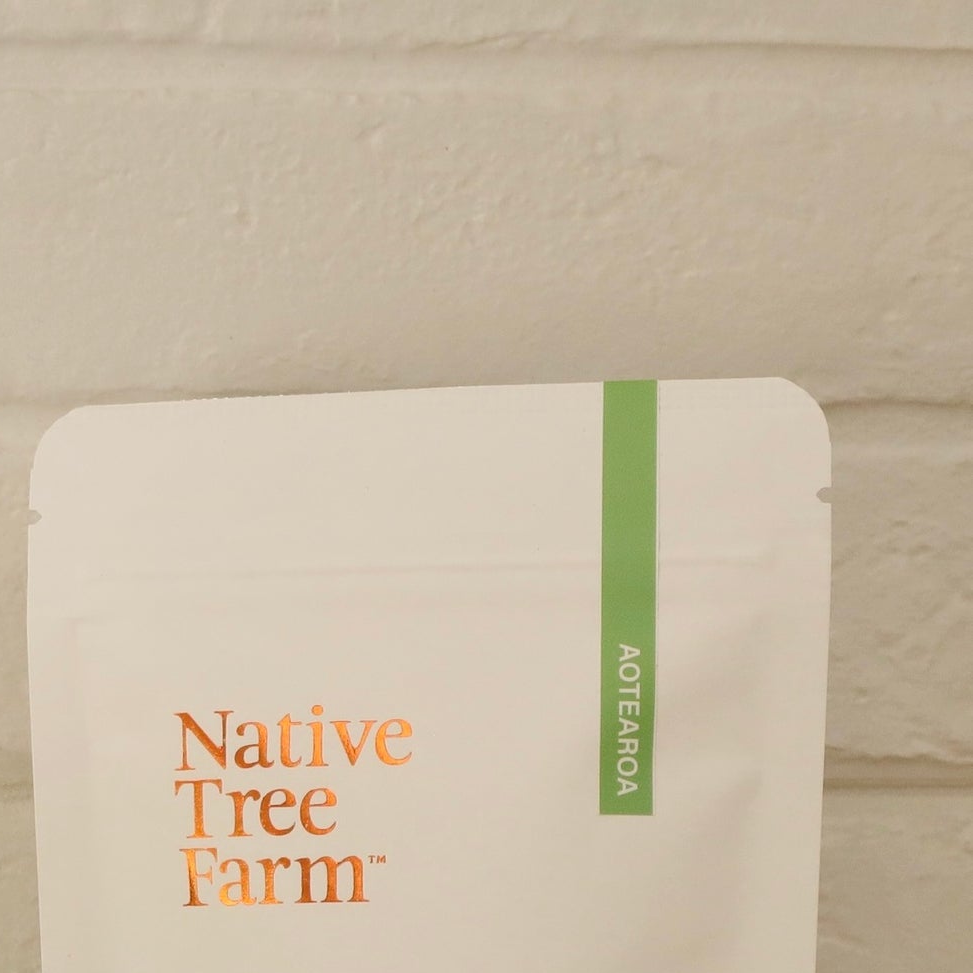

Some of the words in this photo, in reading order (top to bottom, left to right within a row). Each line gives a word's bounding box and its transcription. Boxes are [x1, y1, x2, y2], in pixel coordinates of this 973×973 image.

[173, 705, 412, 771] Native
[615, 644, 642, 796] AOTEAROA
[174, 778, 337, 838] Tree
